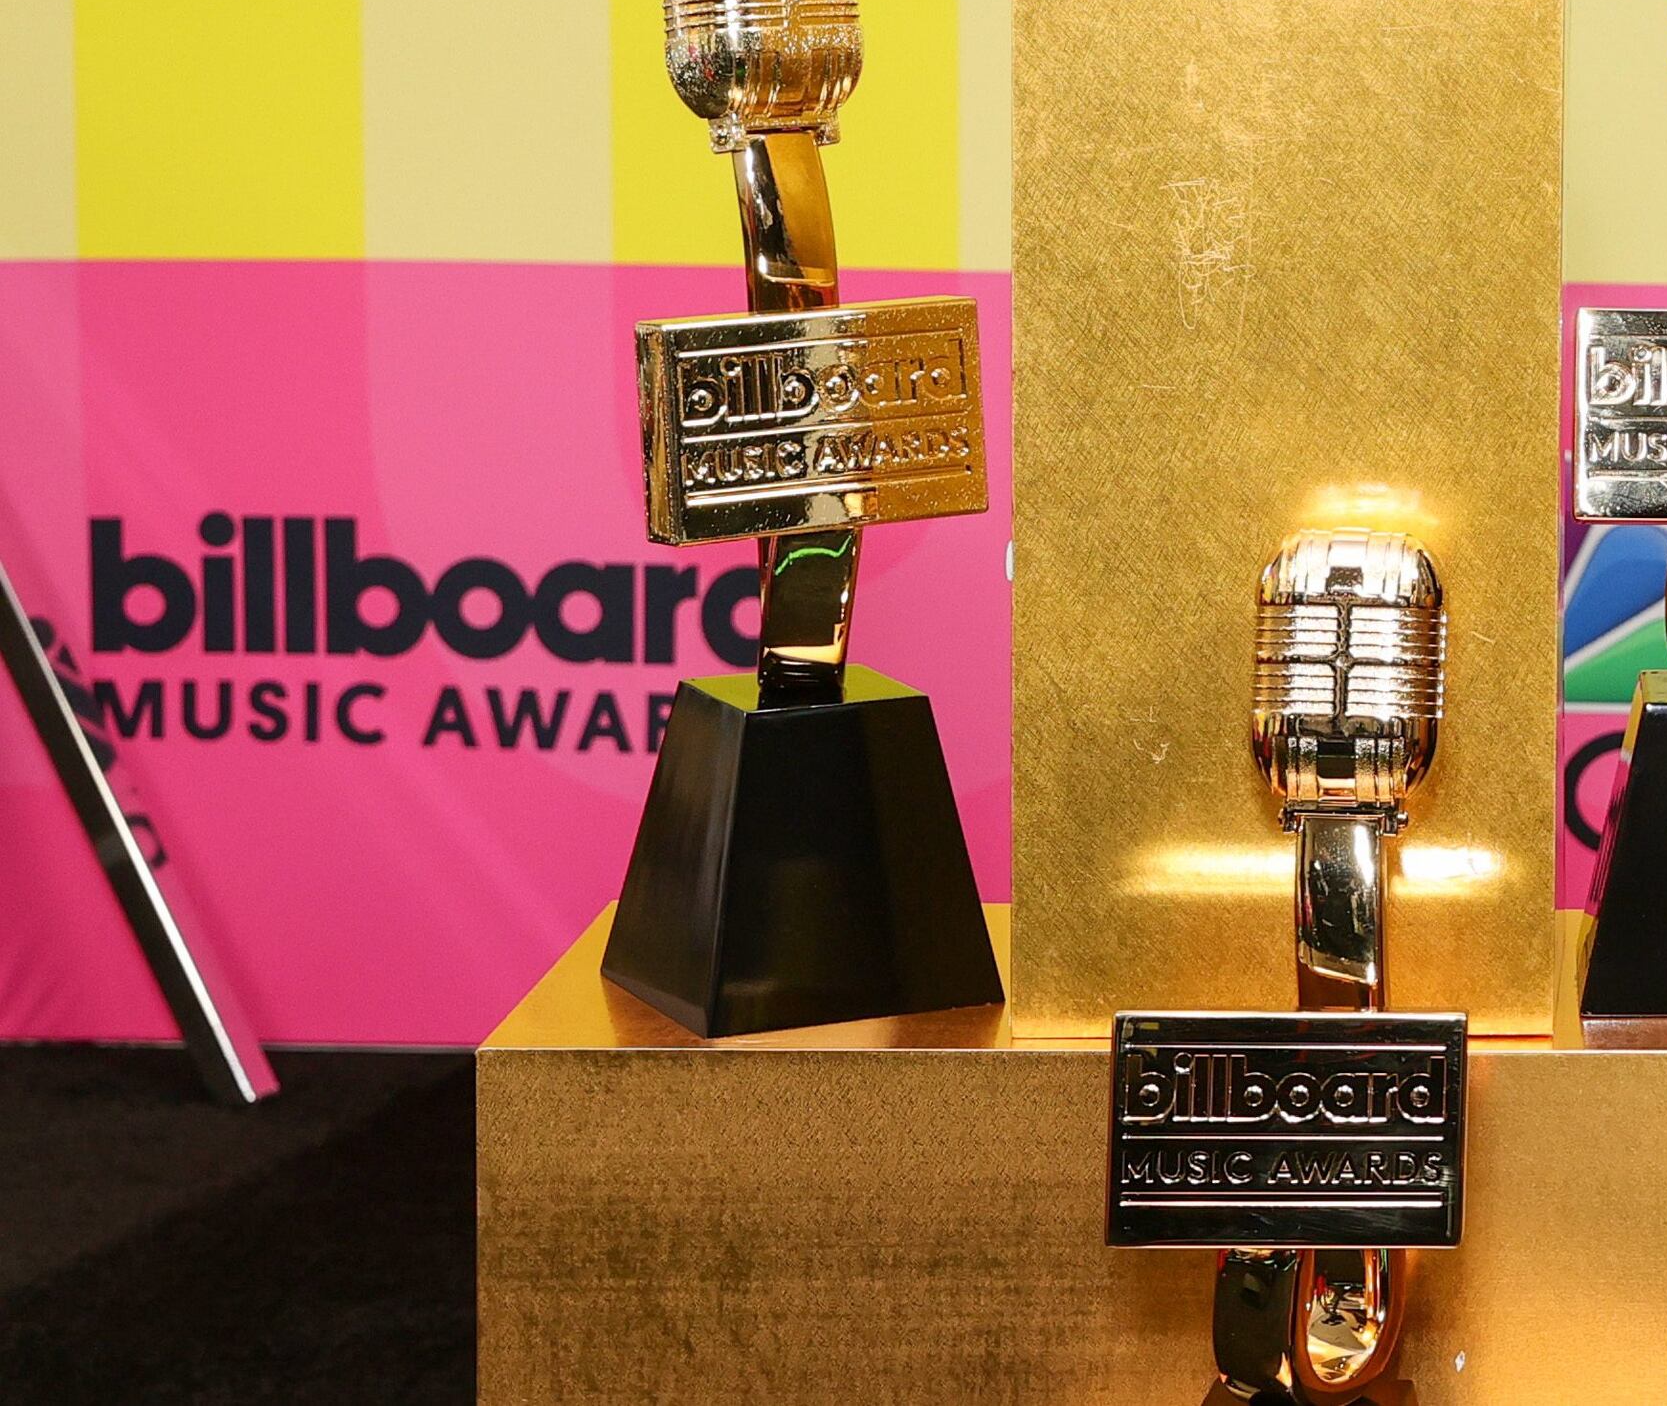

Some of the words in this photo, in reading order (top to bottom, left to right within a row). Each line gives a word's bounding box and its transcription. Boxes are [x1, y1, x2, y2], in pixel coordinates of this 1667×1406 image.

[677, 337, 969, 428] billboard
[680, 442, 809, 486] MUSIC
[812, 425, 970, 474] AWARDS
[92, 679, 389, 745] MUSIC
[1122, 1051, 1449, 1125] billboard
[1119, 1150, 1254, 1186] MUSIC
[1266, 1150, 1445, 1186] AWARDS
